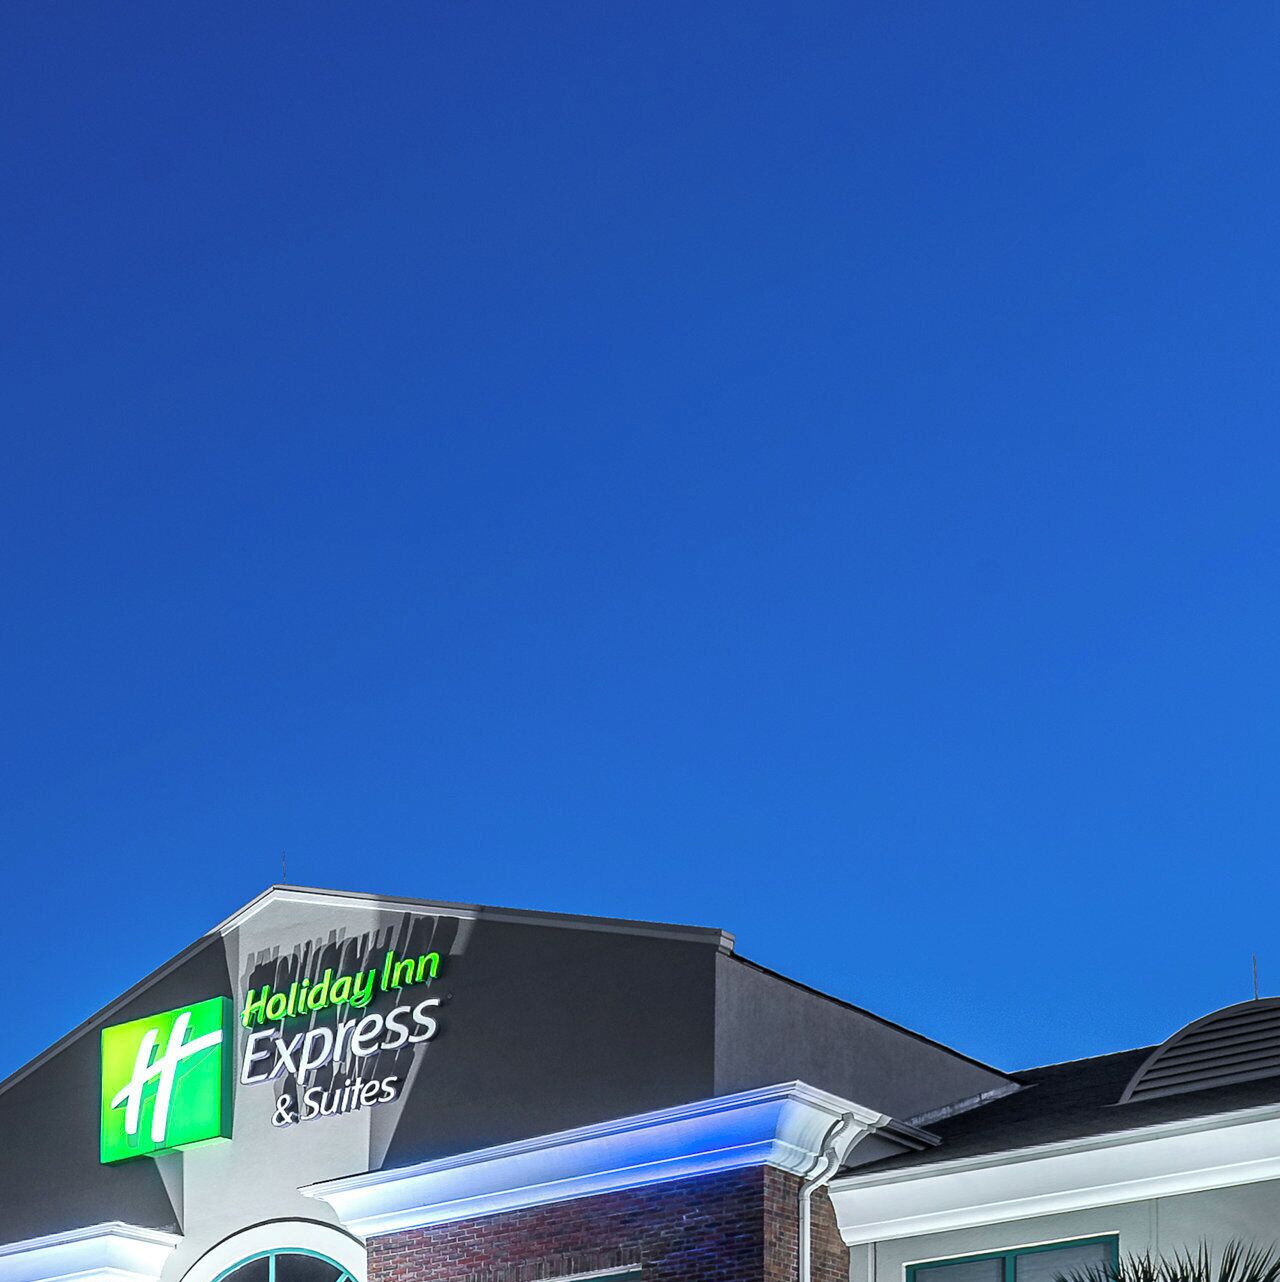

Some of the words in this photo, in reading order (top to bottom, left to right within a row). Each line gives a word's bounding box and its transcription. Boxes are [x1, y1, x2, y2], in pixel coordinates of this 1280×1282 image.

[240, 968, 377, 1029] Holiday
[380, 950, 440, 992] Inn
[240, 998, 441, 1086] Express
[271, 1093, 299, 1127] &
[300, 1075, 398, 1121] Suites
